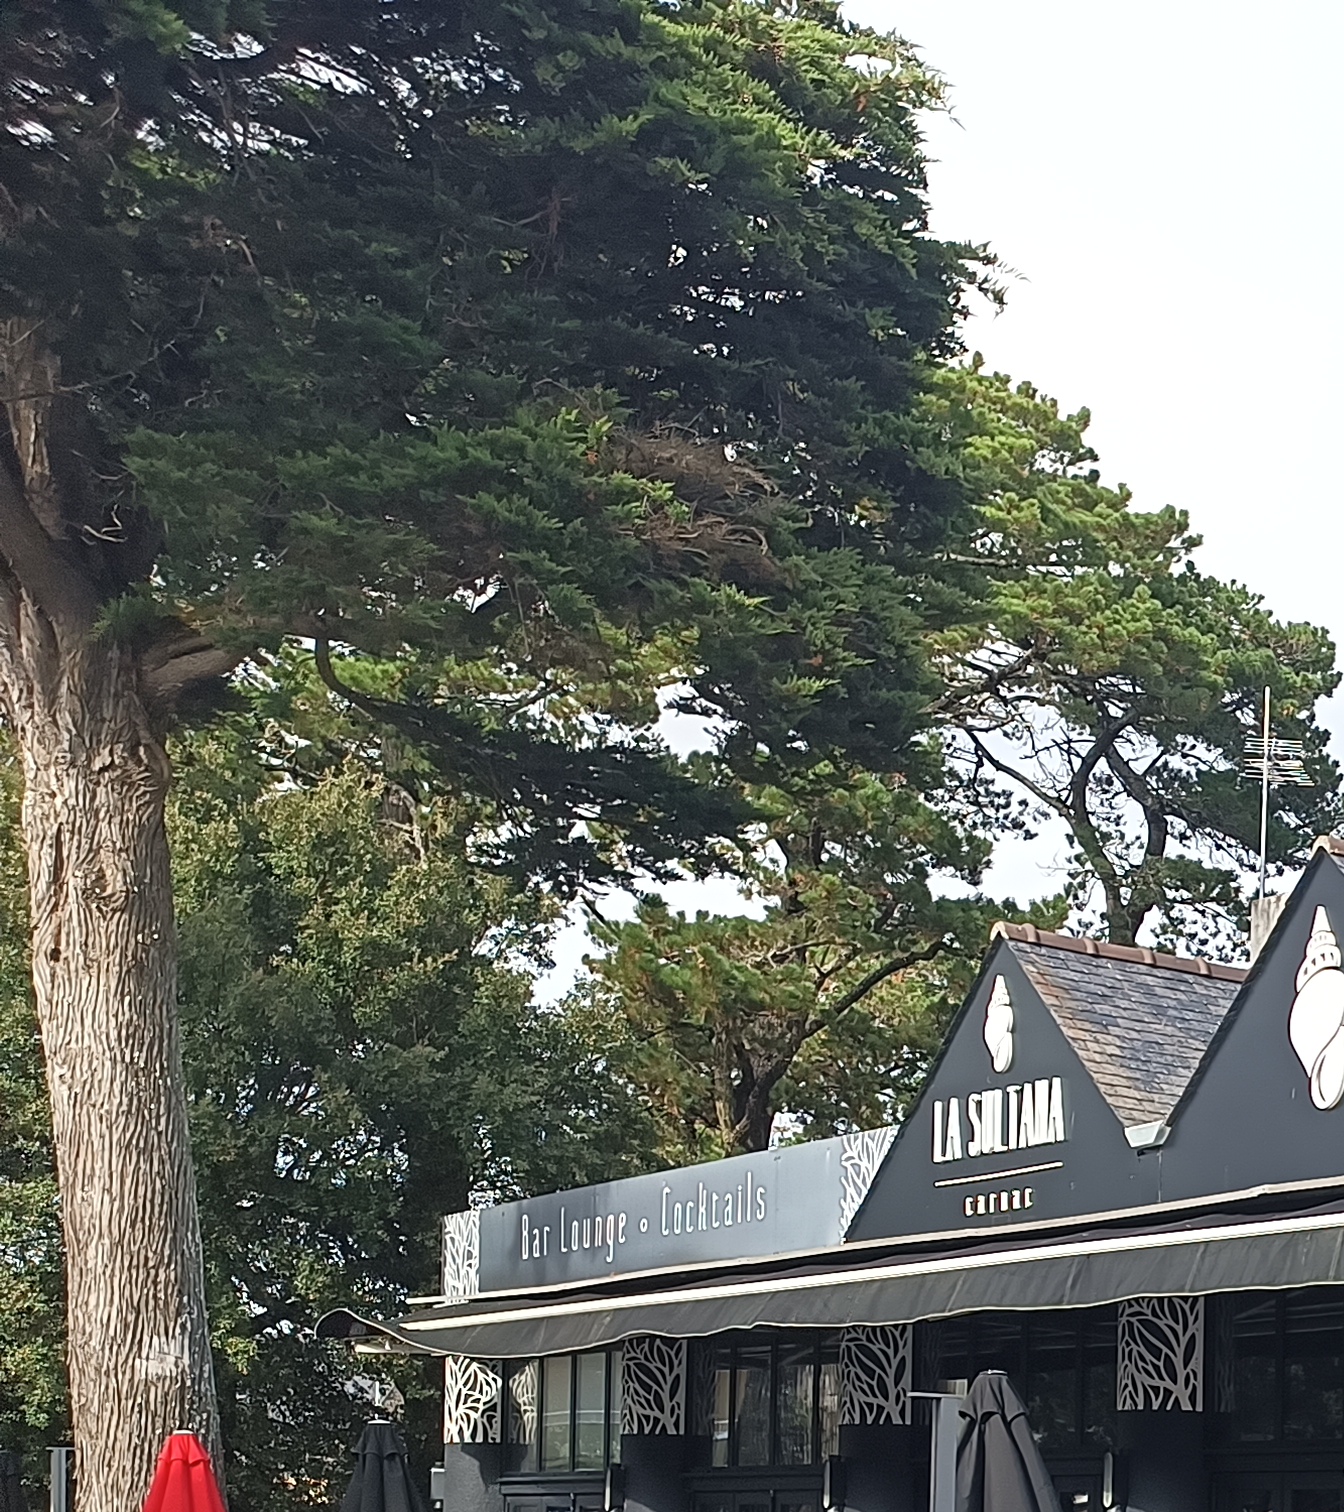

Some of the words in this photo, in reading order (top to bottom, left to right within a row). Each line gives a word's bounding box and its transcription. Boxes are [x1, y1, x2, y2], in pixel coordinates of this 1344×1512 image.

[932, 1097, 962, 1164] LA
[968, 1076, 1066, 1157] SULTANA
[521, 1213, 551, 1260] Bar
[560, 1206, 627, 1263] Lounge
[661, 1171, 766, 1236] Cocktails
[964, 1187, 1034, 1217] carnac
